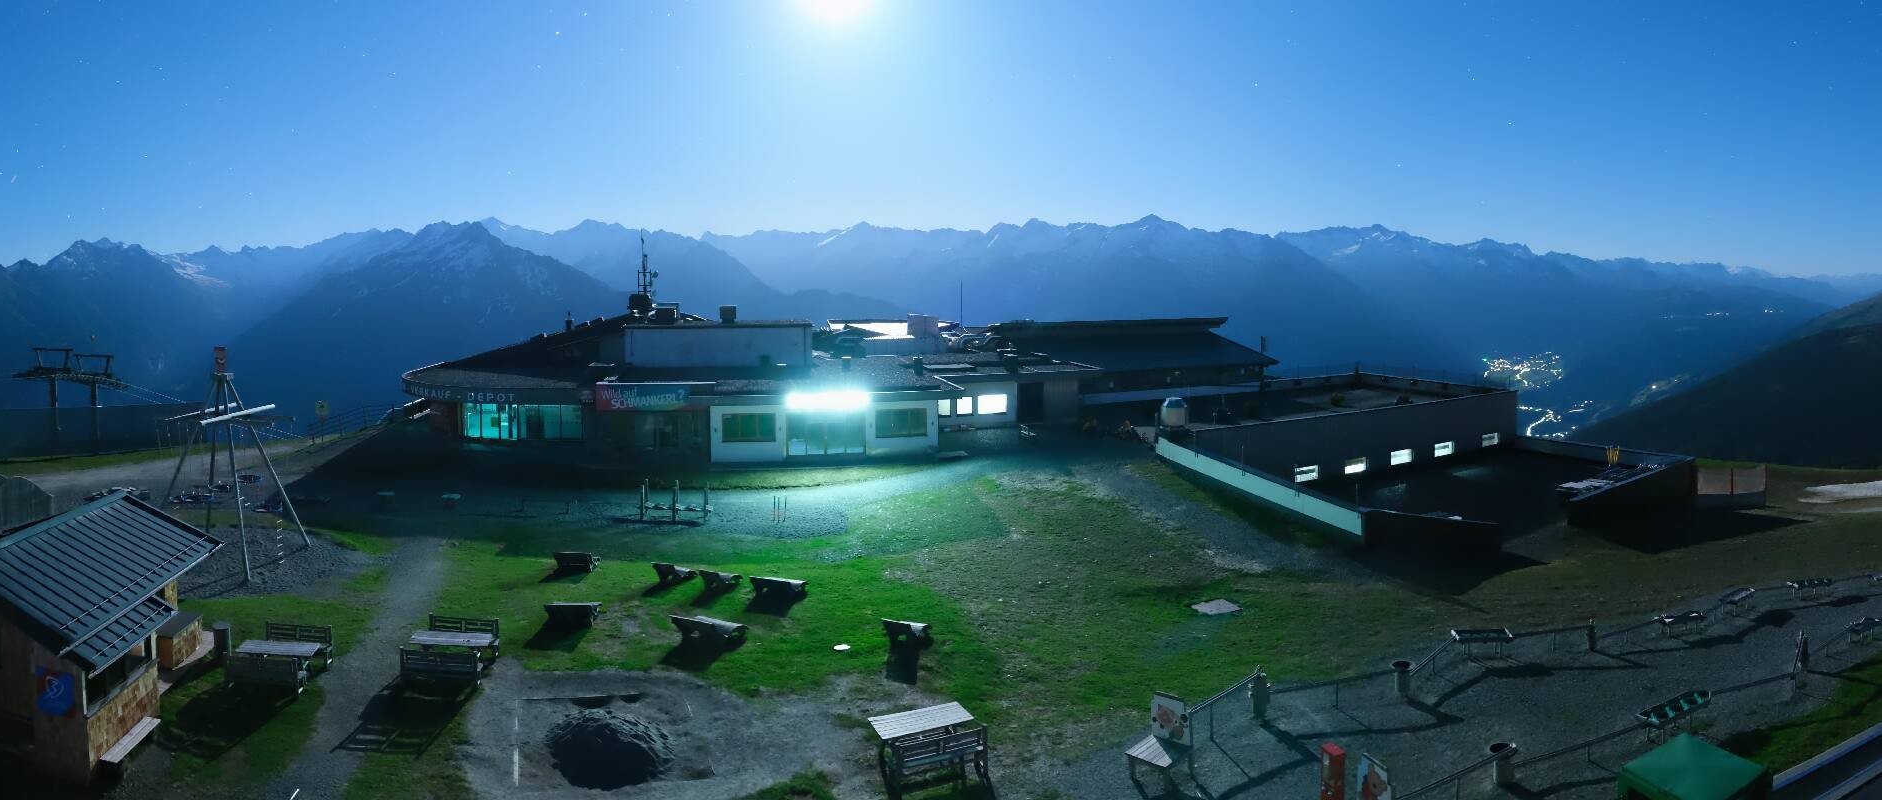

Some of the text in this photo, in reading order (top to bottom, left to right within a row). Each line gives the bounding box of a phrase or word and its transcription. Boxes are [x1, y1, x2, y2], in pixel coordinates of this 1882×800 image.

[467, 392, 515, 402] DEPOT
[601, 386, 637, 400] Wild auf
